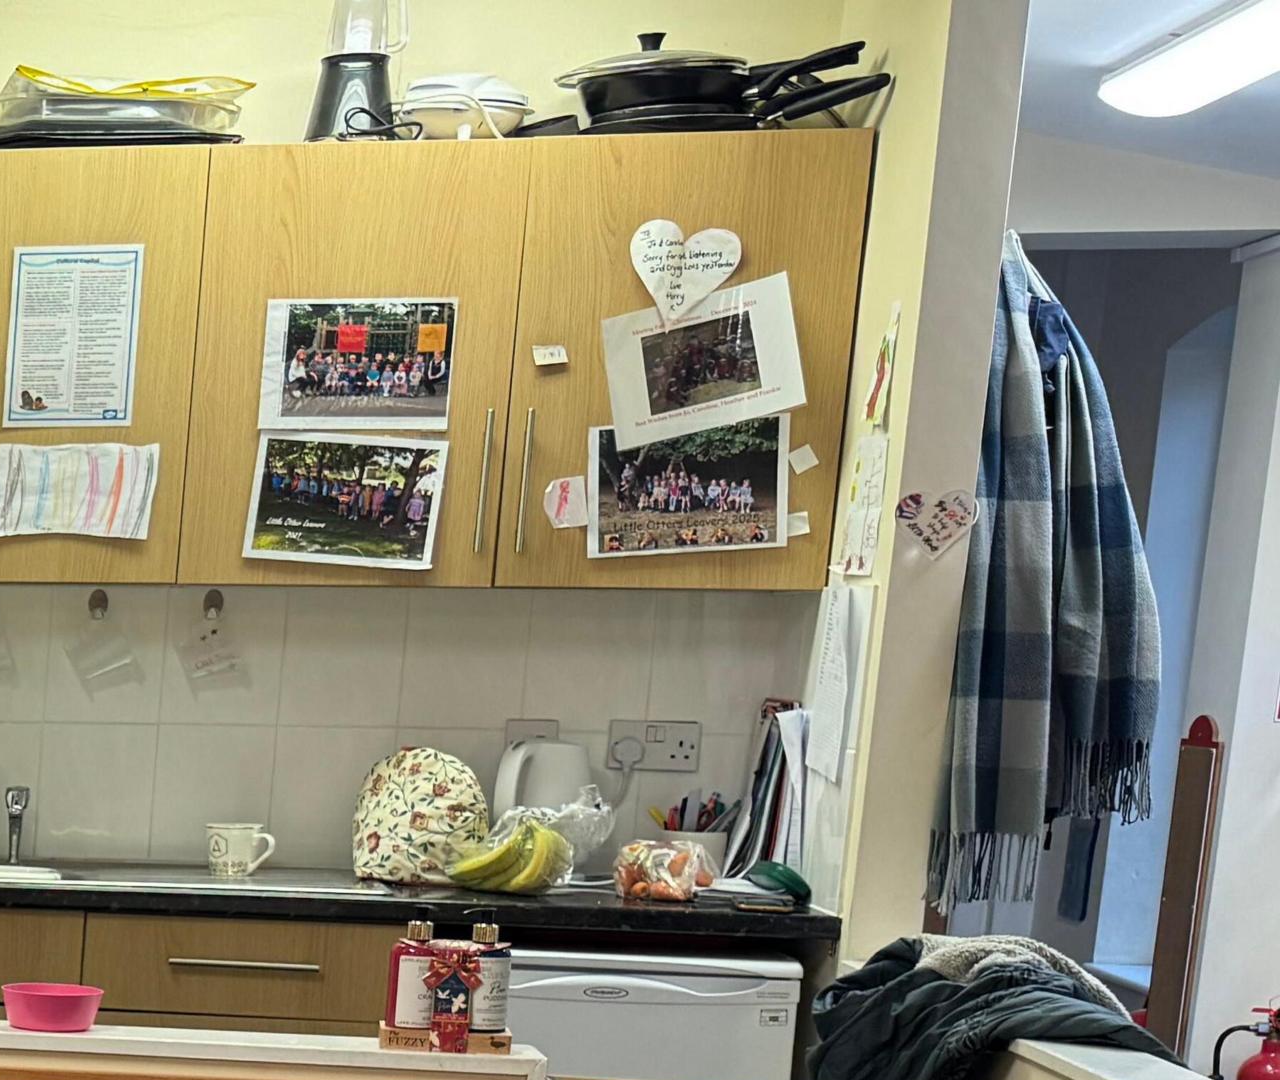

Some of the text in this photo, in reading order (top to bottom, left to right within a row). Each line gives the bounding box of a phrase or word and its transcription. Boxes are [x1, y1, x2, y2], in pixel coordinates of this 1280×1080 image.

[613, 521, 643, 533] Little
[731, 513, 761, 525] 2025
[388, 1037, 426, 1047] FUZZY
